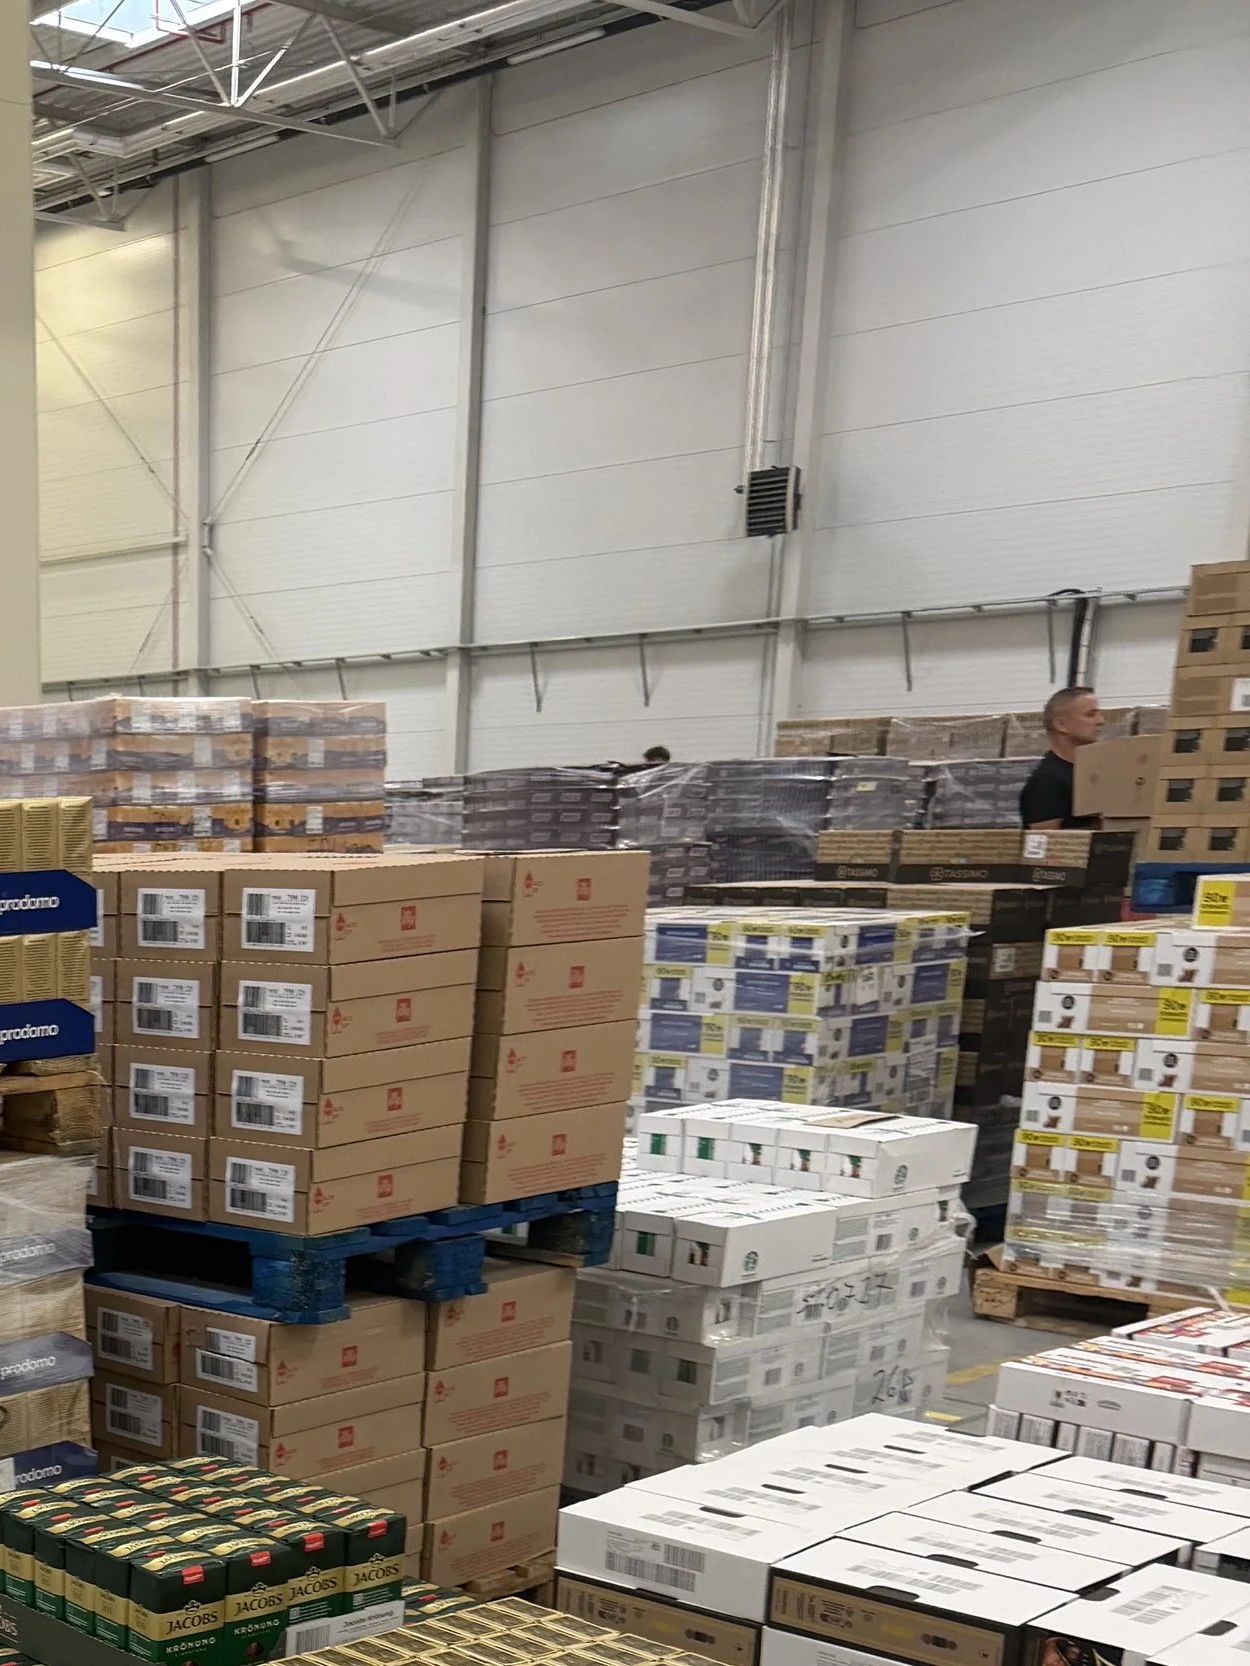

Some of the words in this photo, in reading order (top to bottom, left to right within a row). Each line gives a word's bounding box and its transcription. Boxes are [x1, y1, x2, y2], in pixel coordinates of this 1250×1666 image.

[944, 869, 988, 878] TASSIMO
[0, 1023, 59, 1044] prodomo
[0, 1354, 56, 1379] prodomo
[14, 1463, 62, 1484] rodomo
[352, 1563, 399, 1587] JACOBS
[289, 1576, 338, 1601] JACOBS
[234, 1593, 283, 1616] JACOBS
[166, 1612, 218, 1634] JACOBS
[234, 1618, 280, 1635] KRÖNUNG
[166, 1637, 216, 1654] KRÖNUNG
